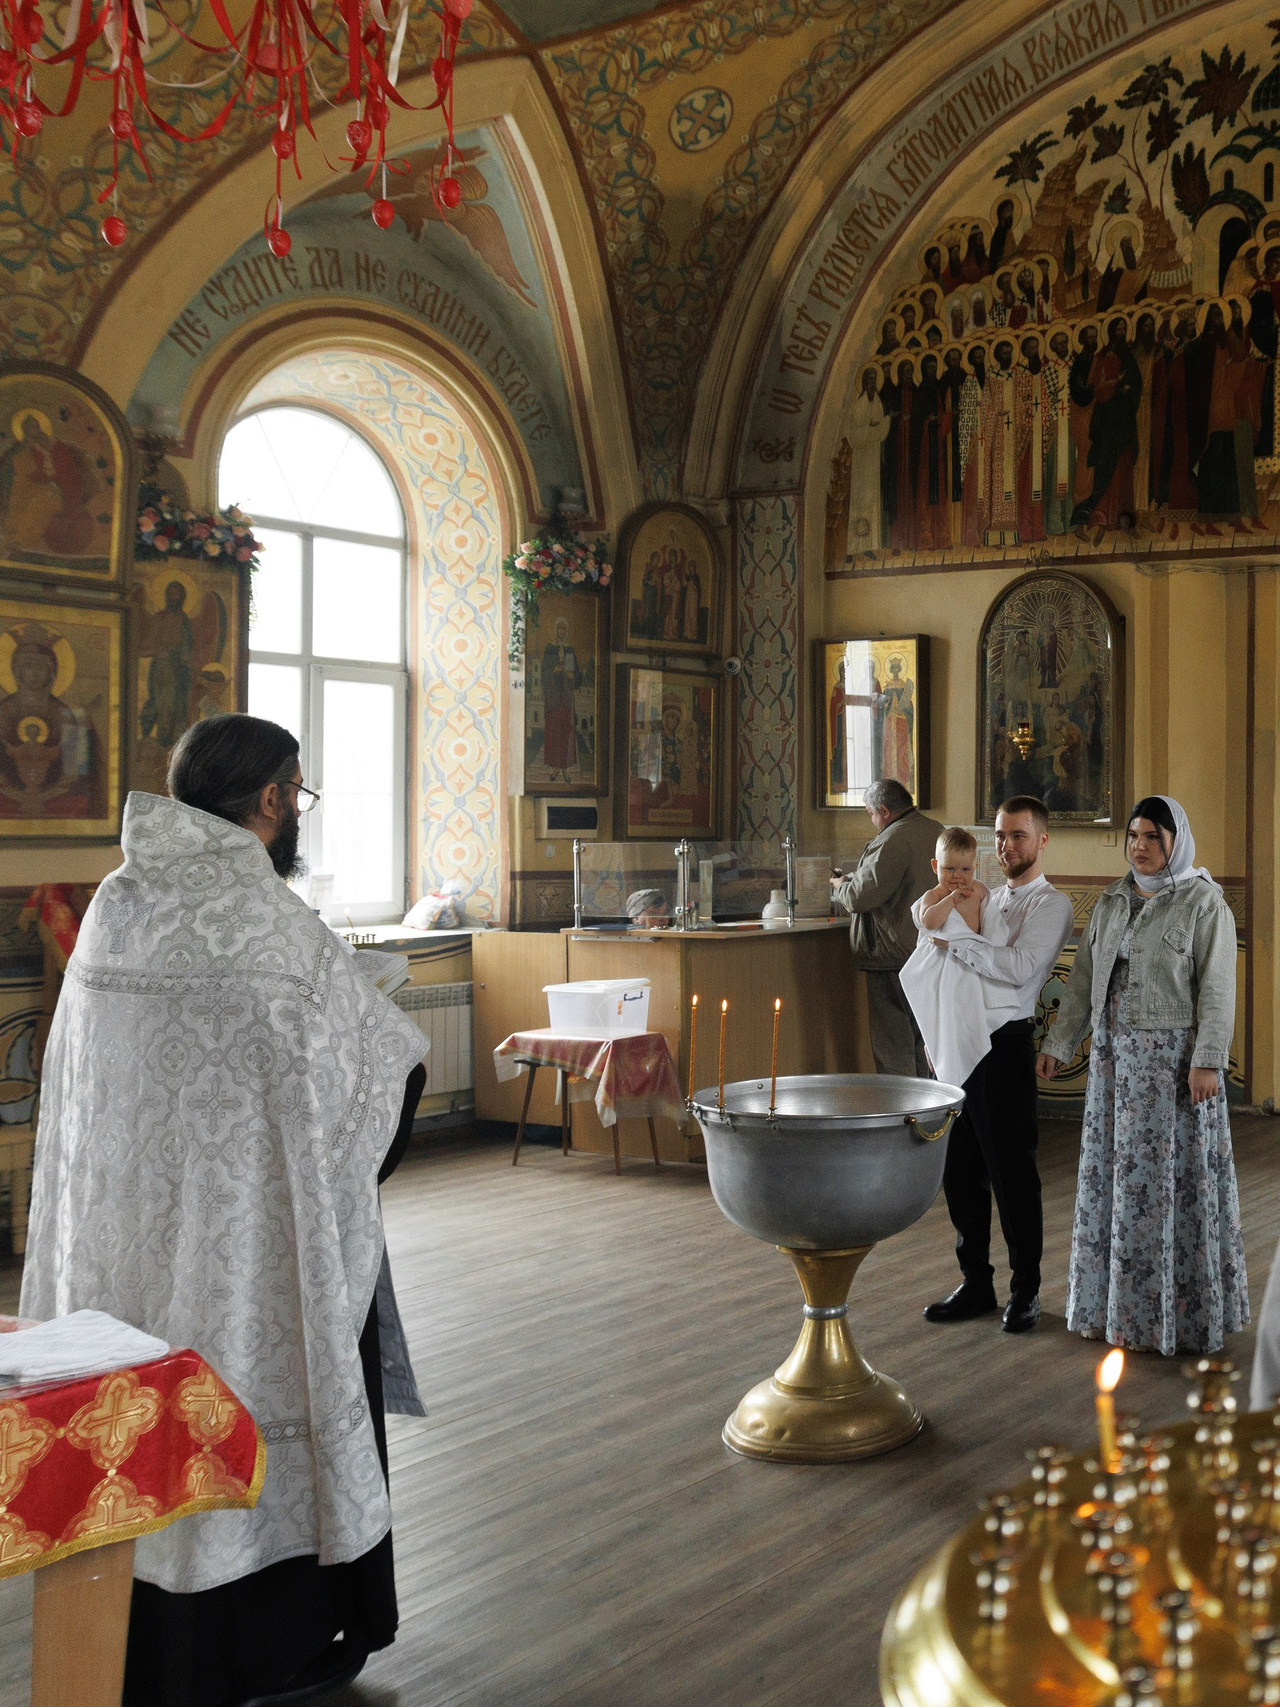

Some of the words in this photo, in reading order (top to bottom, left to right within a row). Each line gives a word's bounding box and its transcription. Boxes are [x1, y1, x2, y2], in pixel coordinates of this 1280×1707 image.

[168, 308, 211, 358] НЕ
[305, 246, 344, 291] ДА
[355, 250, 386, 295] НЕ
